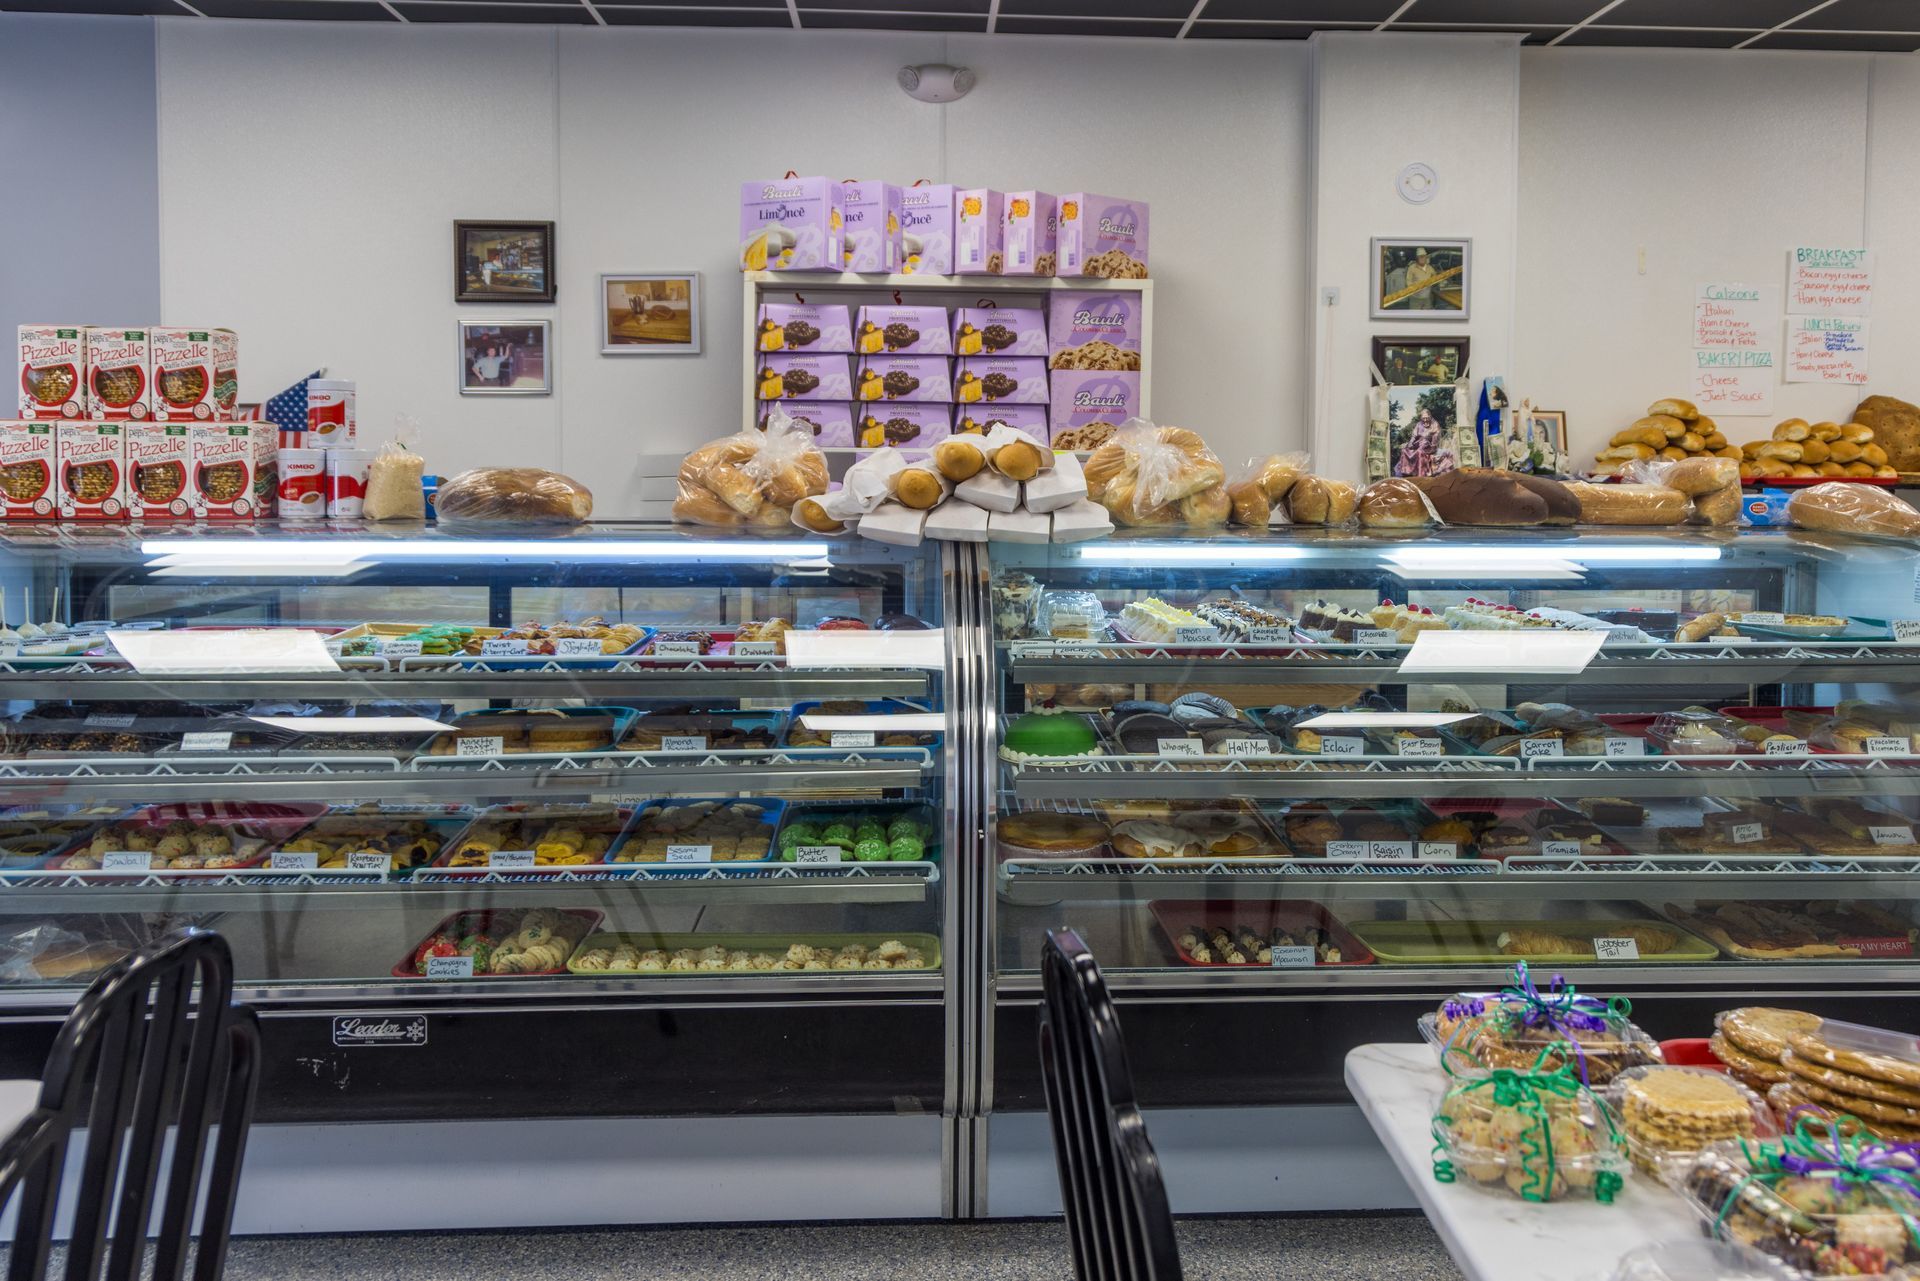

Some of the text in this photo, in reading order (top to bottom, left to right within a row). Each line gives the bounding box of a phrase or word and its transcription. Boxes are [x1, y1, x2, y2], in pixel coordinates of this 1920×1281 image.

[1100, 216, 1136, 235] Bauli
[1797, 248, 1866, 262] BREAKFAST
[1706, 285, 1759, 299] Calzone
[1701, 303, 1734, 316] Italian
[1073, 310, 1125, 326] Bauli
[21, 341, 77, 362] Pizzelle
[90, 343, 144, 364] Pizzelle
[154, 343, 208, 365] Pizzelle
[1697, 351, 1772, 366] BAKERY PIZZA
[1702, 374, 1738, 386] Cheese
[1073, 391, 1125, 406] Bauli
[0, 436, 49, 456] izzelle
[61, 437, 119, 459] Pizzelle
[128, 437, 186, 459] Pizzelle
[193, 437, 248, 459] Pizzelle
[1228, 741, 1269, 755] Half Moon
[1322, 739, 1355, 753] Eclair
[1524, 741, 1556, 750] Carrot
[1525, 748, 1552, 756] Cake
[798, 848, 825, 856] Butter
[1372, 843, 1404, 854] Raisin
[1424, 842, 1451, 856] Corn
[672, 852, 694, 860] Seed
[1601, 948, 1620, 957] Tail
[1866, 943, 1878, 951] MY
[1881, 941, 1907, 951] HEART
[430, 959, 468, 968] Champagne
[429, 968, 460, 976] Cookies
[336, 1018, 406, 1037] Leader
